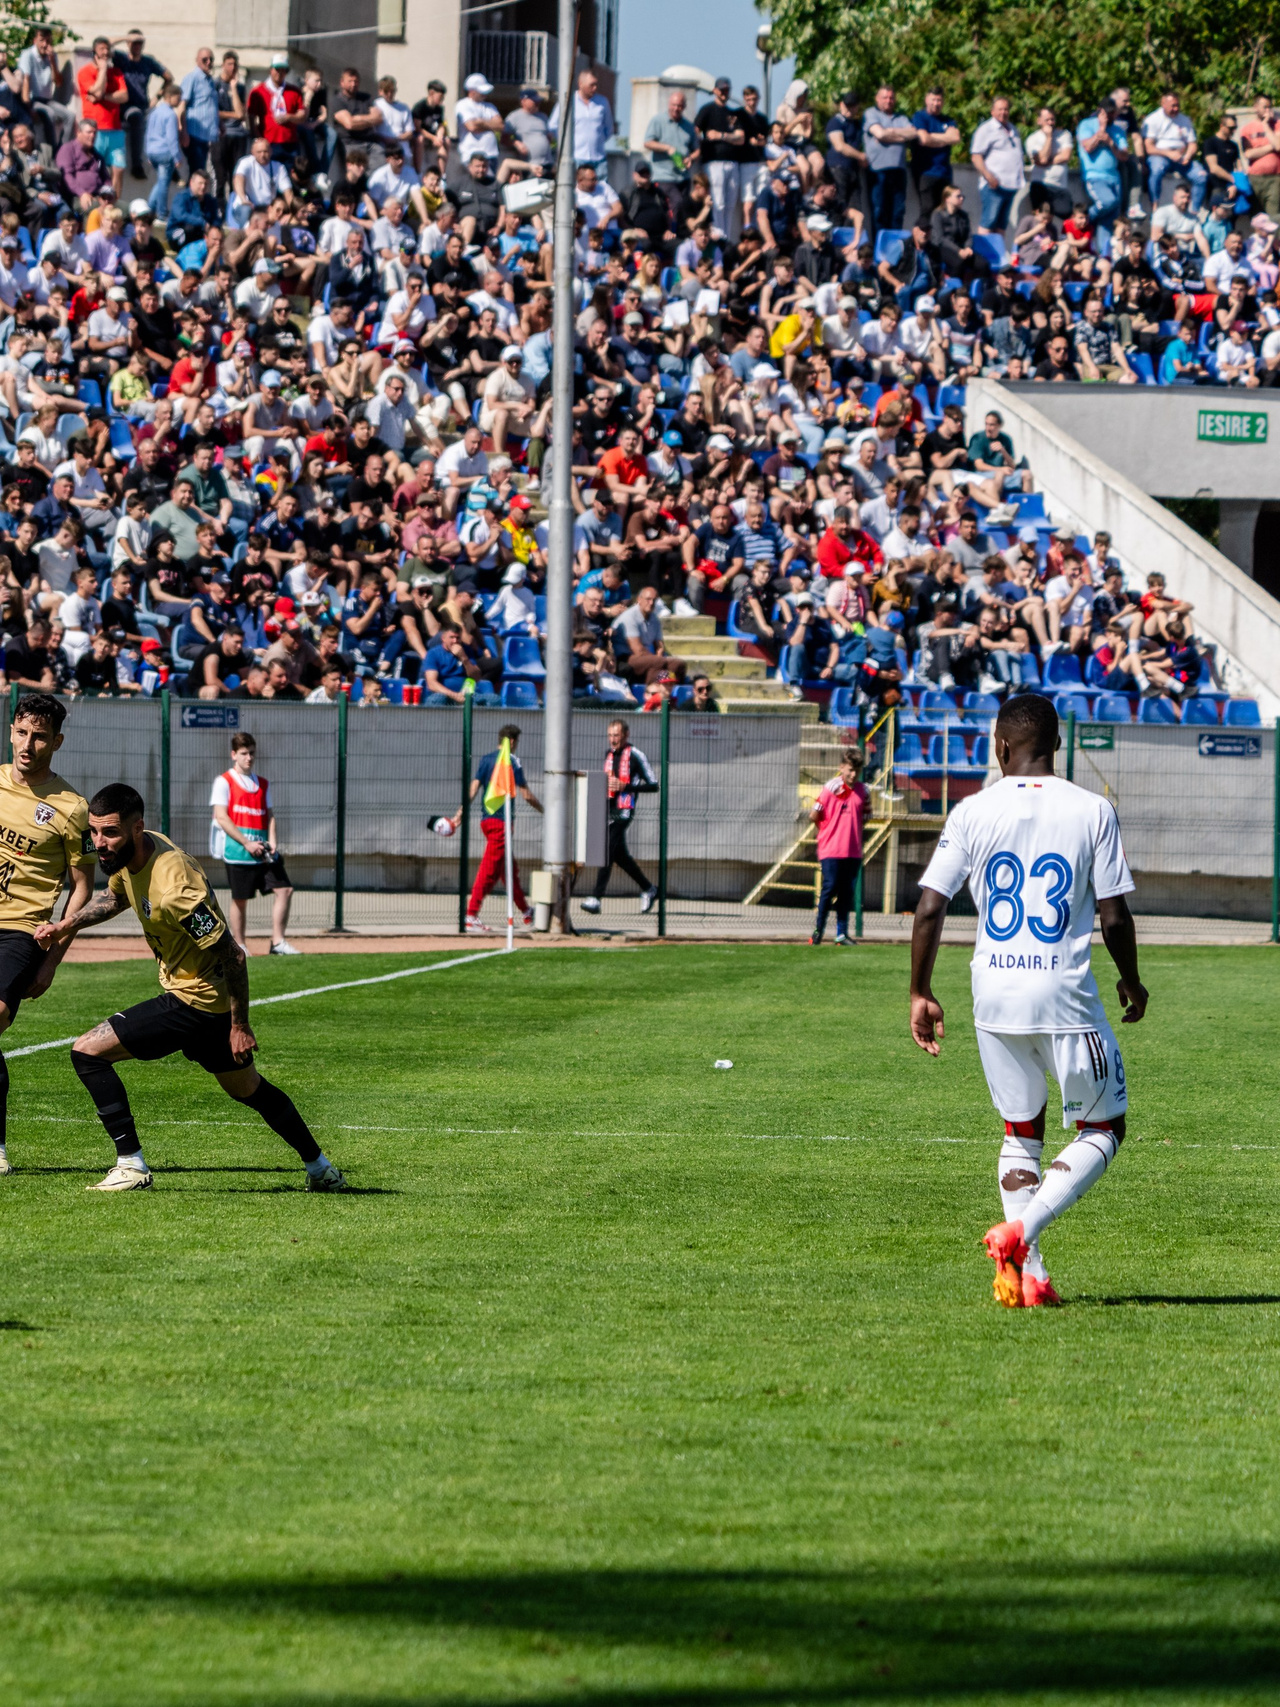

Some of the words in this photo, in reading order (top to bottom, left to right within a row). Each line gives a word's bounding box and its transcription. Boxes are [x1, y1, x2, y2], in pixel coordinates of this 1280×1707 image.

[1199, 414, 1251, 437] IESIRE
[1255, 417, 1266, 438] 2
[985, 851, 1073, 943] 83
